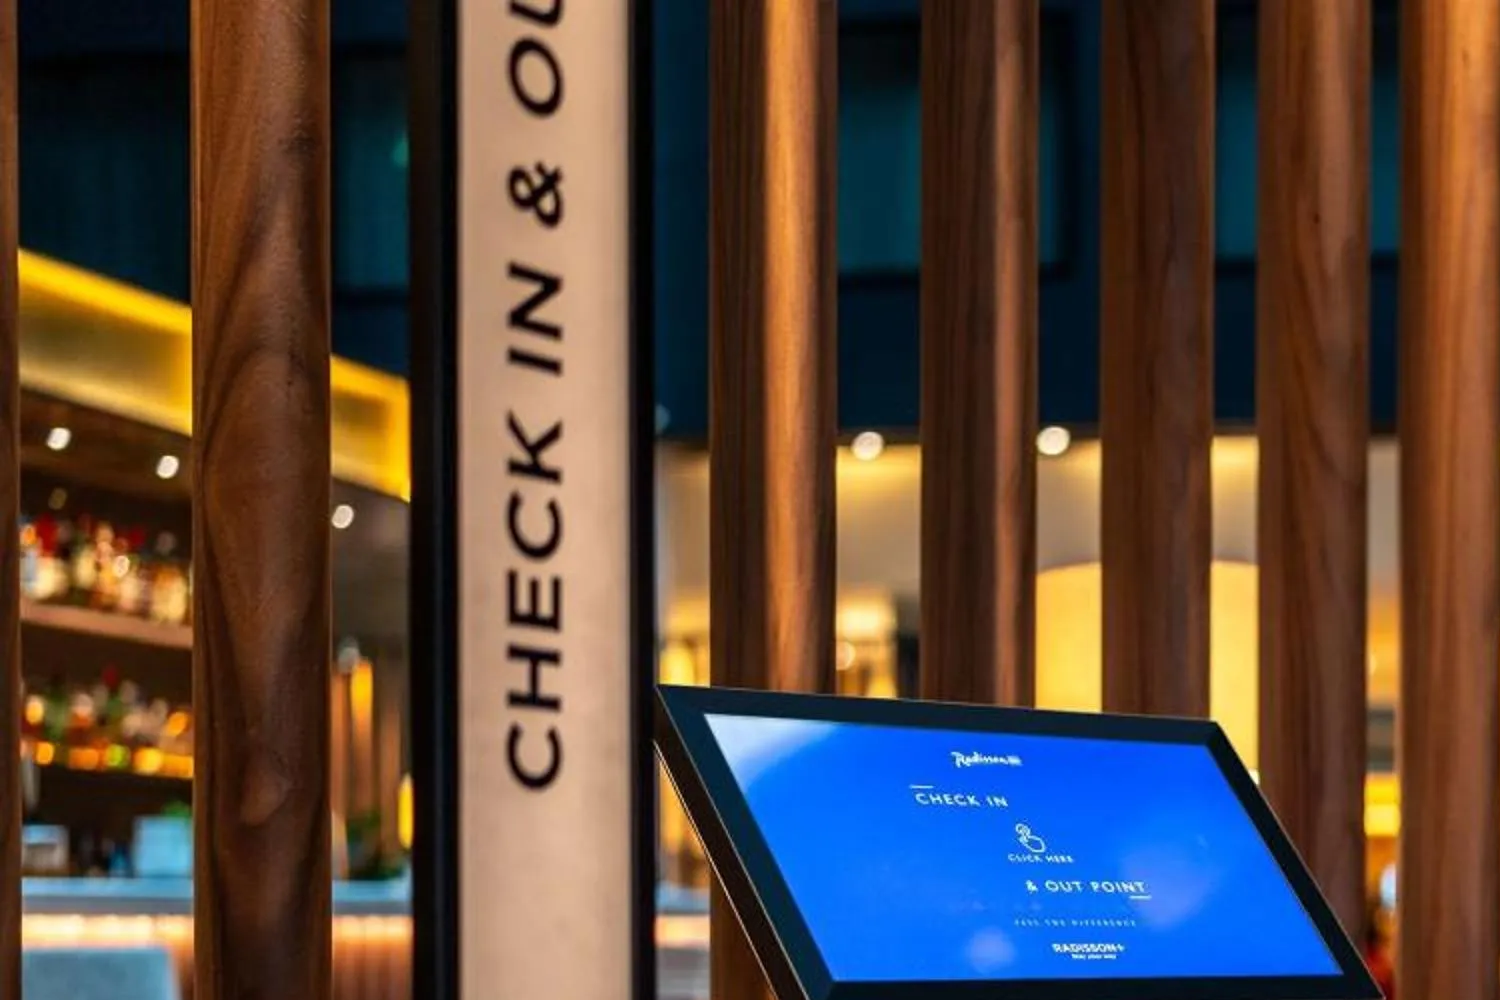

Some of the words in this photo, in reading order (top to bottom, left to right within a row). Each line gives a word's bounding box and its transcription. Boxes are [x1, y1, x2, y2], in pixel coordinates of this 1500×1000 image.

[507, 160, 563, 230] &
[506, 260, 563, 378] IN
[506, 409, 564, 792] CHECK
[914, 792, 981, 807] CHECK
[985, 794, 1009, 808] IN
[1007, 853, 1043, 863] CLICK
[1025, 879, 1039, 893] &
[1045, 880, 1083, 893] OUT
[1089, 881, 1146, 893] POINT
